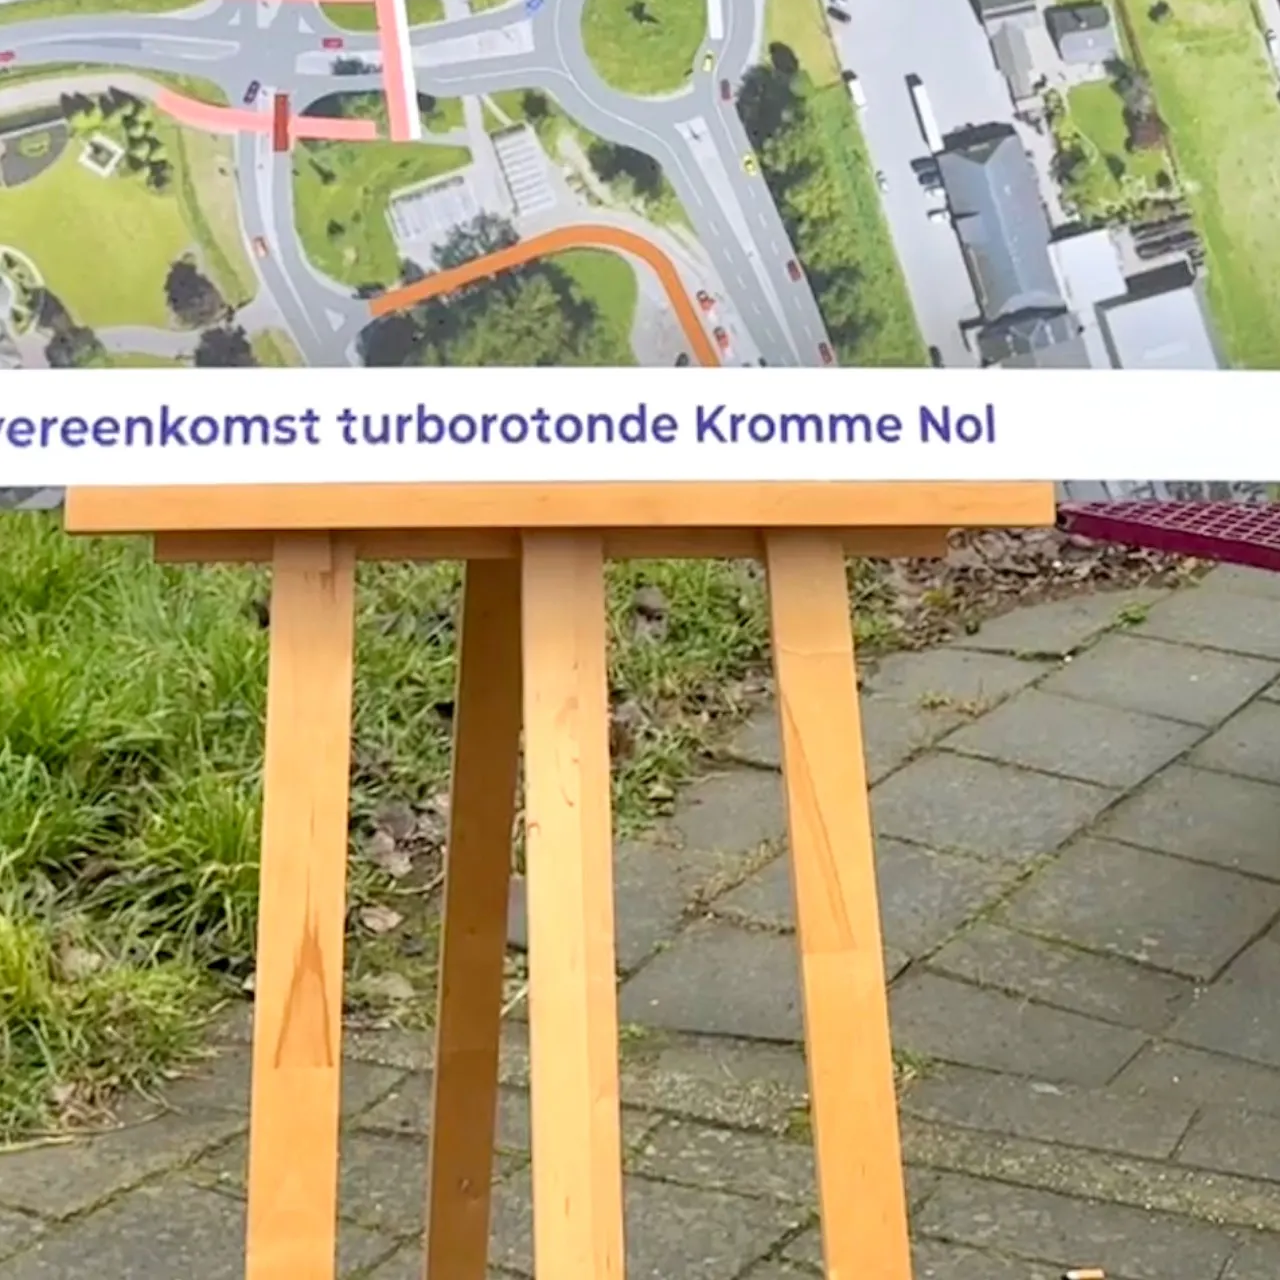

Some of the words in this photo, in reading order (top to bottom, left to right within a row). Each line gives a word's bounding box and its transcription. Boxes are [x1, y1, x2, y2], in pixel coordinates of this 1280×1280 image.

[337, 404, 679, 444] turborotonde
[695, 405, 903, 443] Kromme
[919, 404, 996, 444] Nol
